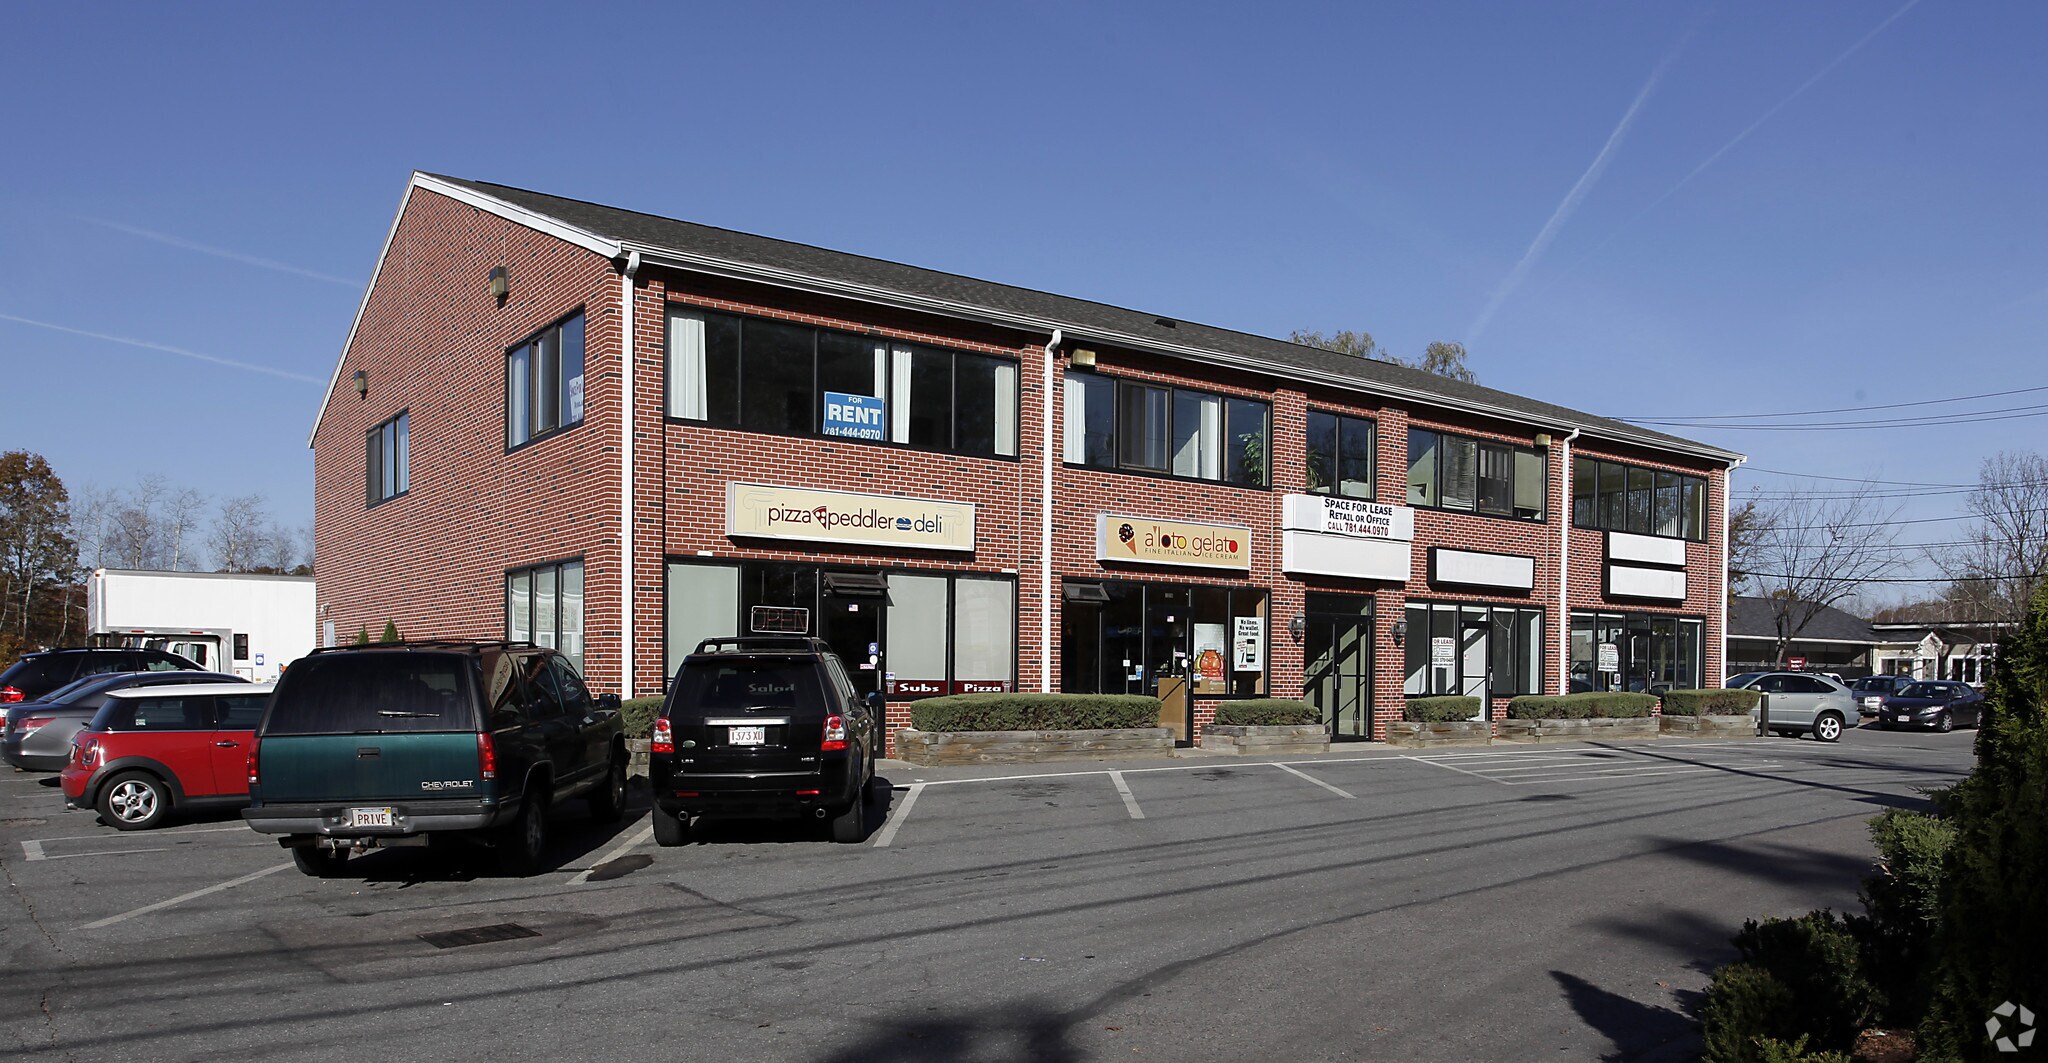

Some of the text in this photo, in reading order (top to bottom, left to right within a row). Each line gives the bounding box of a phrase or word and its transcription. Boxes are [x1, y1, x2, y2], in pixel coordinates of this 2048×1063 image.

[848, 396, 863, 404] FOR
[828, 403, 881, 425] RENT
[825, 426, 880, 440] 781-444-0970
[1324, 498, 1393, 516] SPACE FOR LEASE
[768, 503, 943, 534] pizza peddler deli
[1329, 510, 1354, 522] RETAIL
[1366, 514, 1390, 526] OFFICE
[1327, 521, 1389, 537] CALL 781.444.0970
[1191, 531, 1239, 557] gelato
[1144, 547, 1239, 560] FINE ITALIAN ICE CREAM
[753, 608, 808, 631] OPEN
[748, 683, 795, 693] Salad
[900, 683, 1002, 693] Subs Pizza
[421, 780, 474, 788] CHEVROLET
